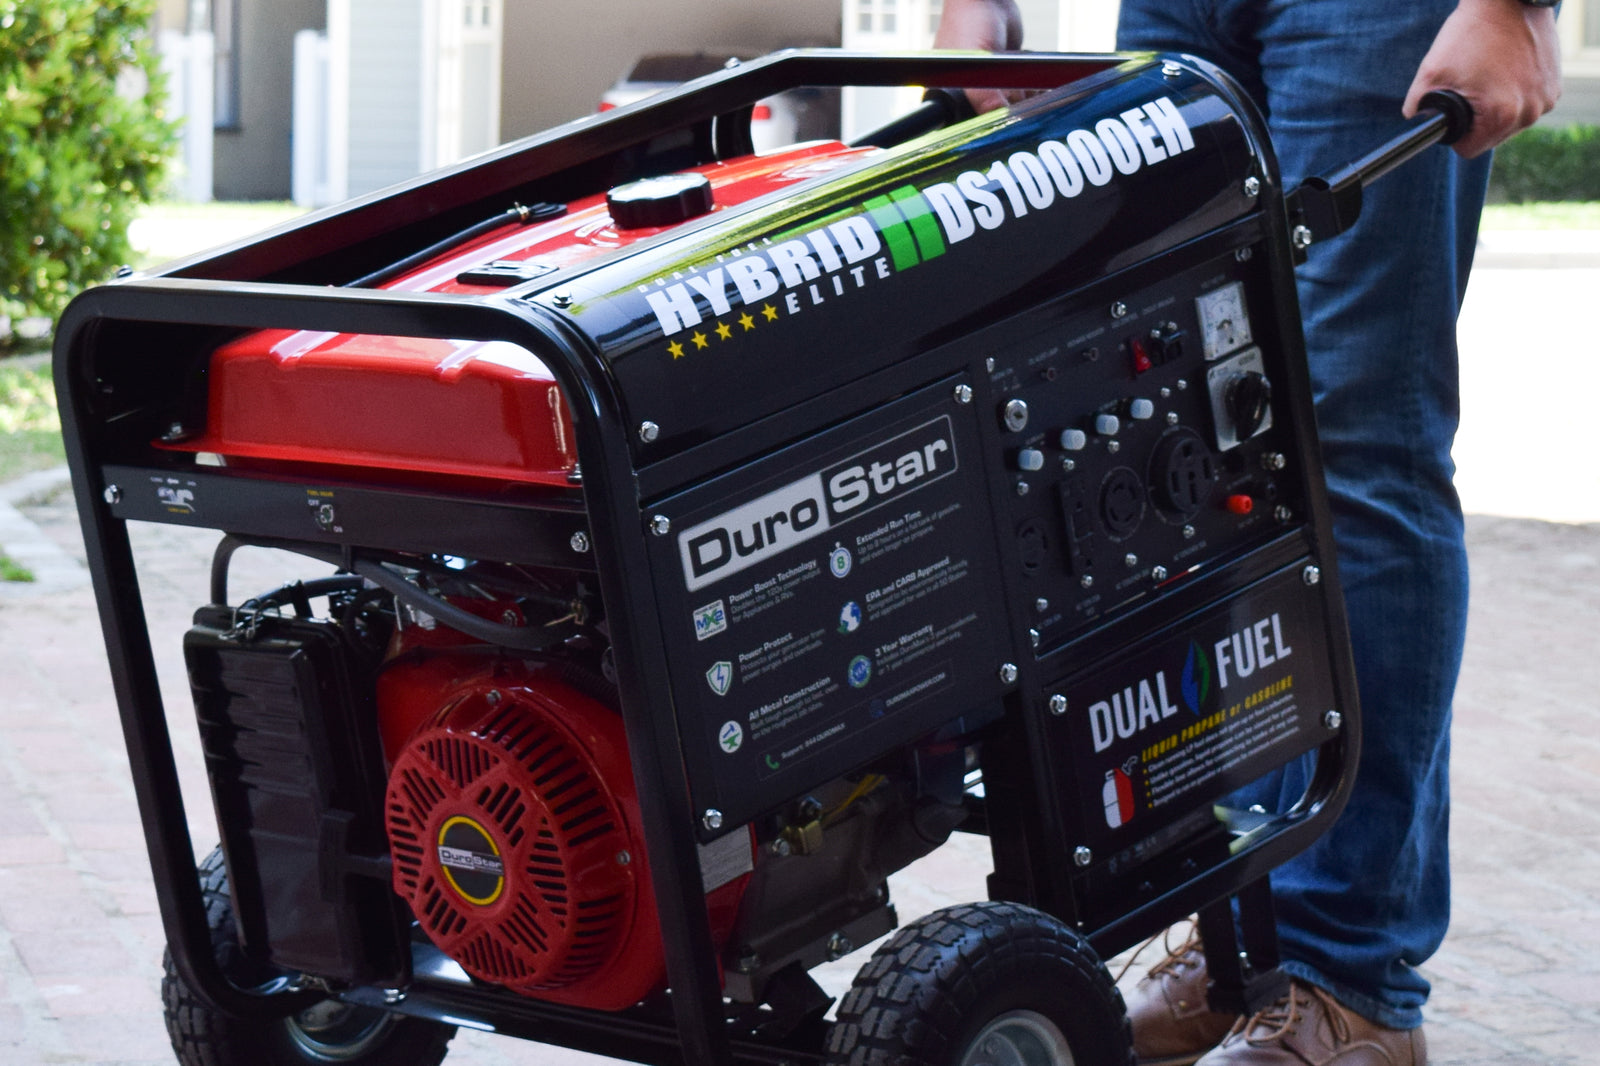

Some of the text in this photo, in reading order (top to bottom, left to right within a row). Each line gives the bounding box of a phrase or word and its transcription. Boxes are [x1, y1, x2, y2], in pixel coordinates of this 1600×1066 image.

[923, 96, 1195, 244] DS10000EH
[638, 237, 772, 293] DUAL FUEL
[645, 217, 881, 337] HYBRID
[785, 257, 890, 315] ELITE
[856, 510, 921, 544] Extended Run Time
[729, 559, 816, 603] Power Boost Technology
[865, 557, 949, 601] EPA and CARB Approved
[696, 608, 724, 631] MX2
[875, 624, 933, 657] 3 Year Warranty
[739, 633, 792, 662] Power Protect
[748, 677, 831, 720] All Metal Construction
[1089, 612, 1292, 753] DUAL FUEL
[1141, 675, 1293, 763] LIQUID PROPANE or GASOLINE
[441, 850, 502, 868] DuroStar
